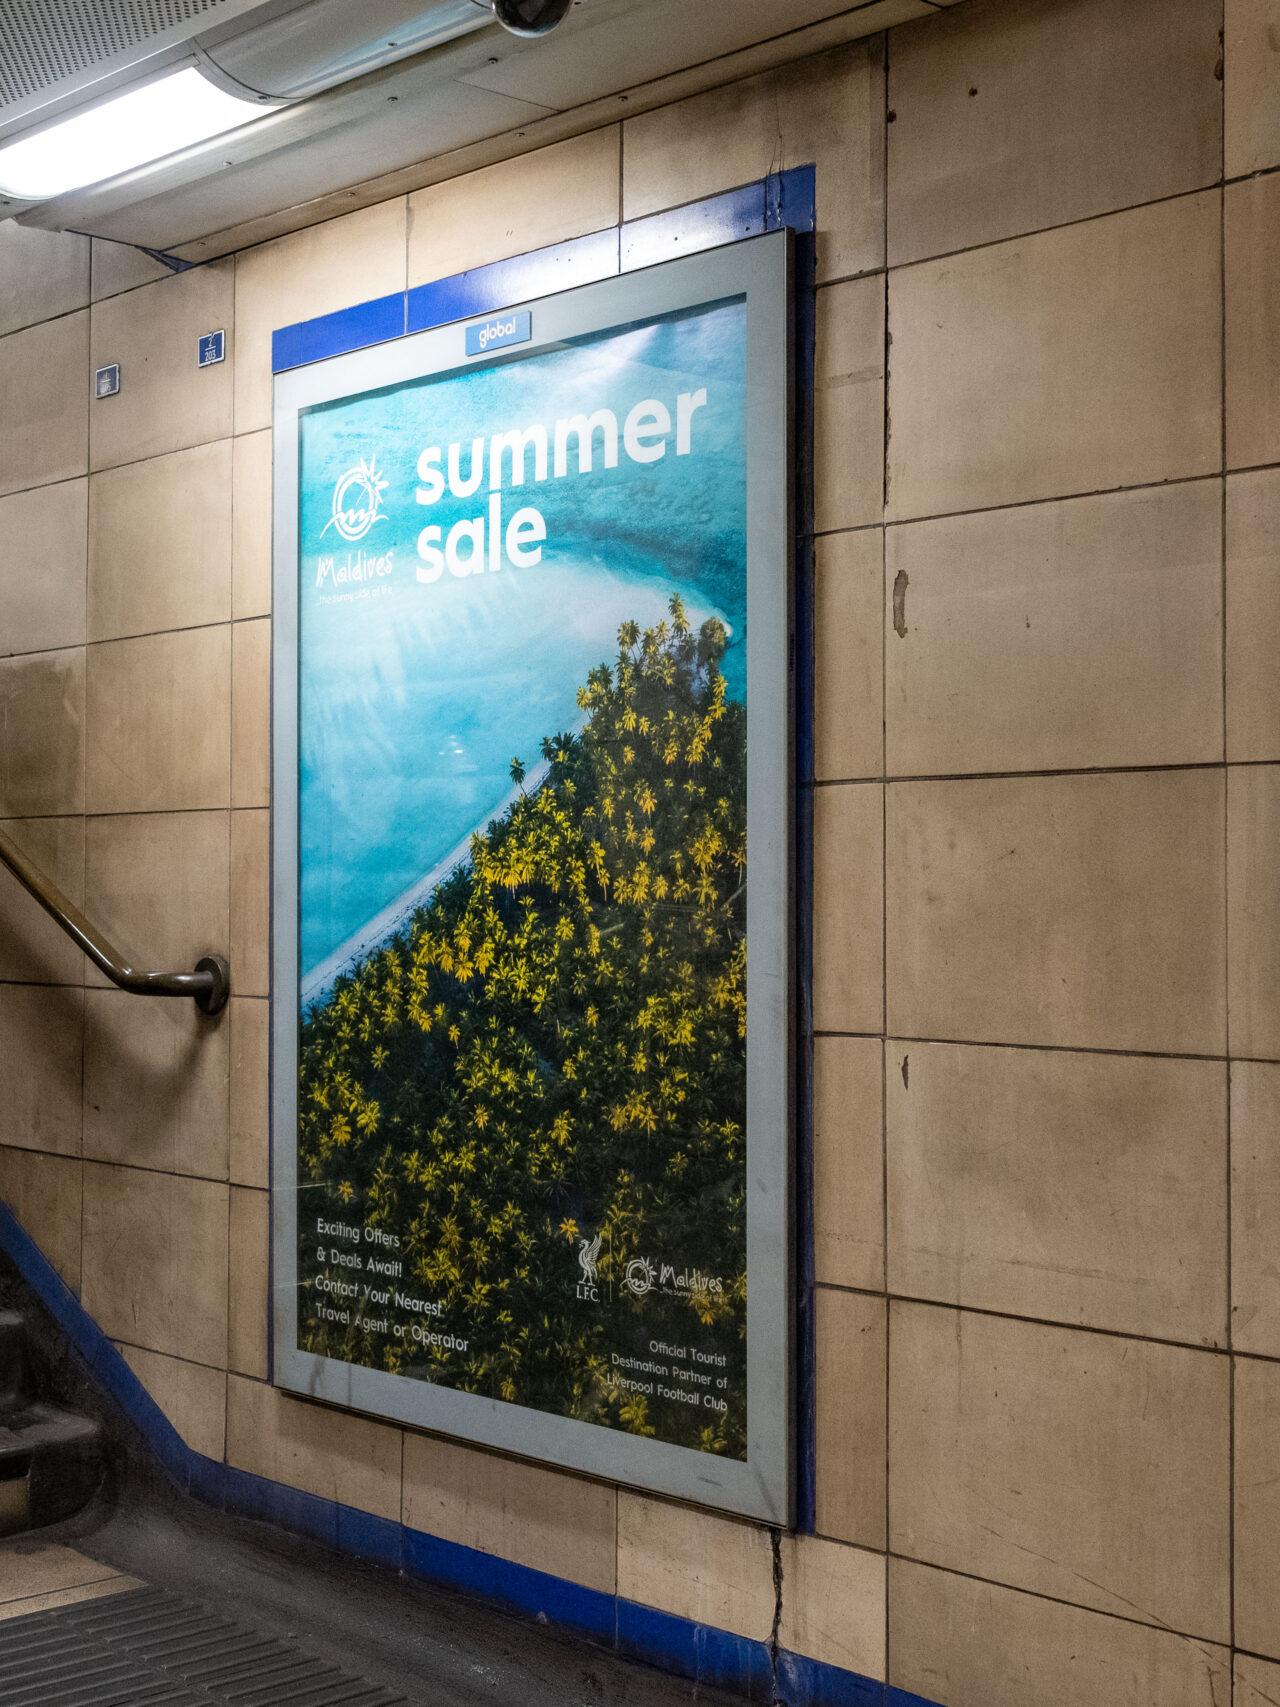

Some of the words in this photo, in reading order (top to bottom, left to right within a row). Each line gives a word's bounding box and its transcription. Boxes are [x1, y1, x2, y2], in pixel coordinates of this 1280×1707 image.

[479, 316, 516, 348] global
[416, 388, 707, 506] summer
[416, 492, 547, 584] sale
[315, 550, 393, 588] Maldives
[317, 1218, 360, 1243] Exciting
[365, 1227, 400, 1247] Offers
[316, 1247, 326, 1262] &
[331, 1249, 362, 1269] Deals
[366, 1256, 402, 1278] Await!
[660, 1263, 723, 1293] Maldives
[315, 1275, 358, 1297] Contact
[363, 1284, 390, 1304] Your
[395, 1292, 442, 1316] Nearest
[315, 1303, 350, 1325] Travel
[354, 1315, 389, 1334] Agent
[393, 1324, 407, 1337] or
[411, 1325, 470, 1352] Operator
[611, 1353, 668, 1376] Destination
[672, 1366, 712, 1385] Partner
[716, 1377, 728, 1389] of
[649, 1340, 686, 1359] Official
[690, 1348, 727, 1367] Tourist
[606, 1372, 653, 1394] Liverpool
[658, 1384, 699, 1405] Football
[703, 1395, 728, 1411] Club
